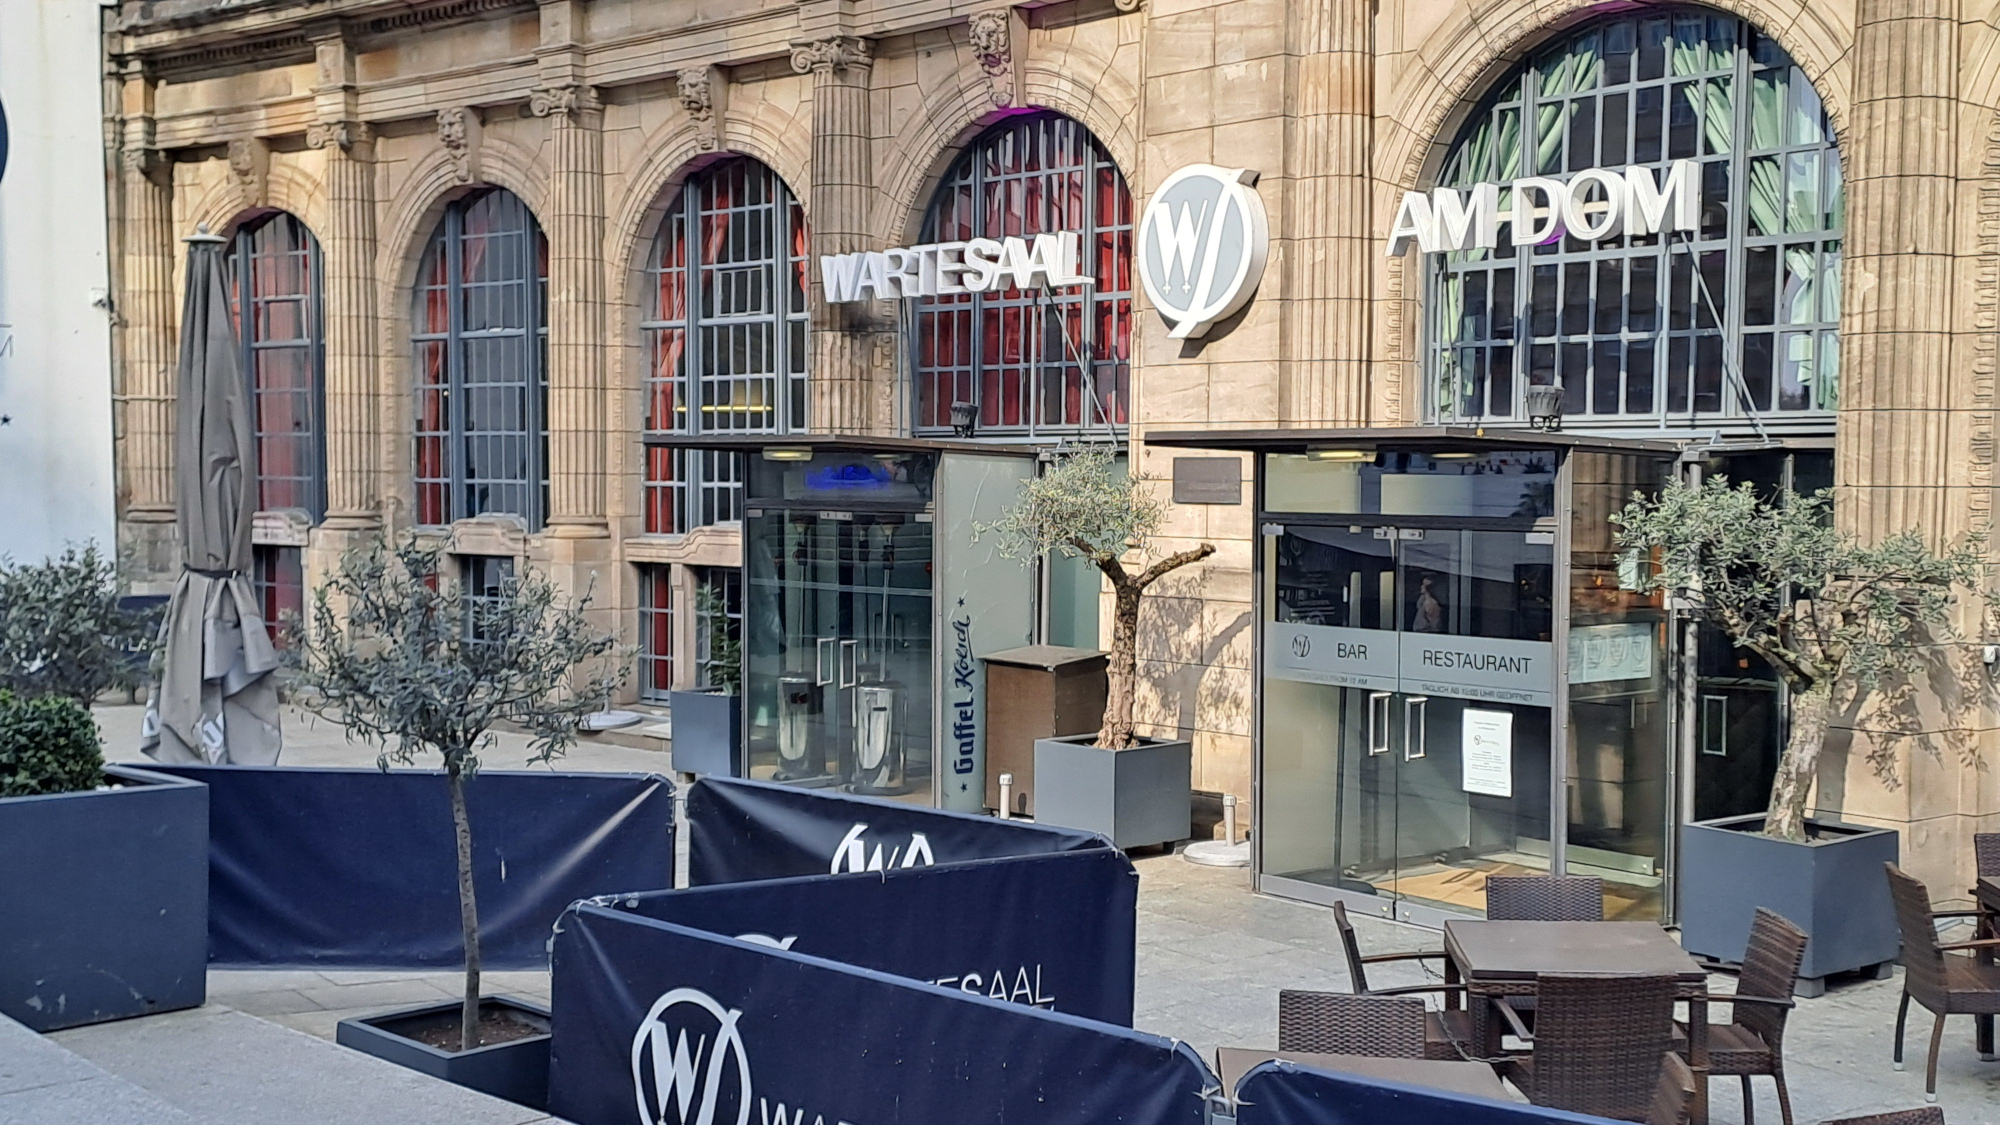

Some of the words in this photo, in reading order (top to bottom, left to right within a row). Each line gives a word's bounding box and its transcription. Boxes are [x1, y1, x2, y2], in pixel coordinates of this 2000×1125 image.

[1385, 182, 1499, 257] AM
[1512, 159, 1699, 247] DOM
[820, 230, 1095, 303] WARTESAAL
[952, 614, 975, 693] Kölsch
[1337, 642, 1368, 660] BAR
[1423, 649, 1532, 674] RESTAURANT
[953, 697, 976, 775] Gaffel
